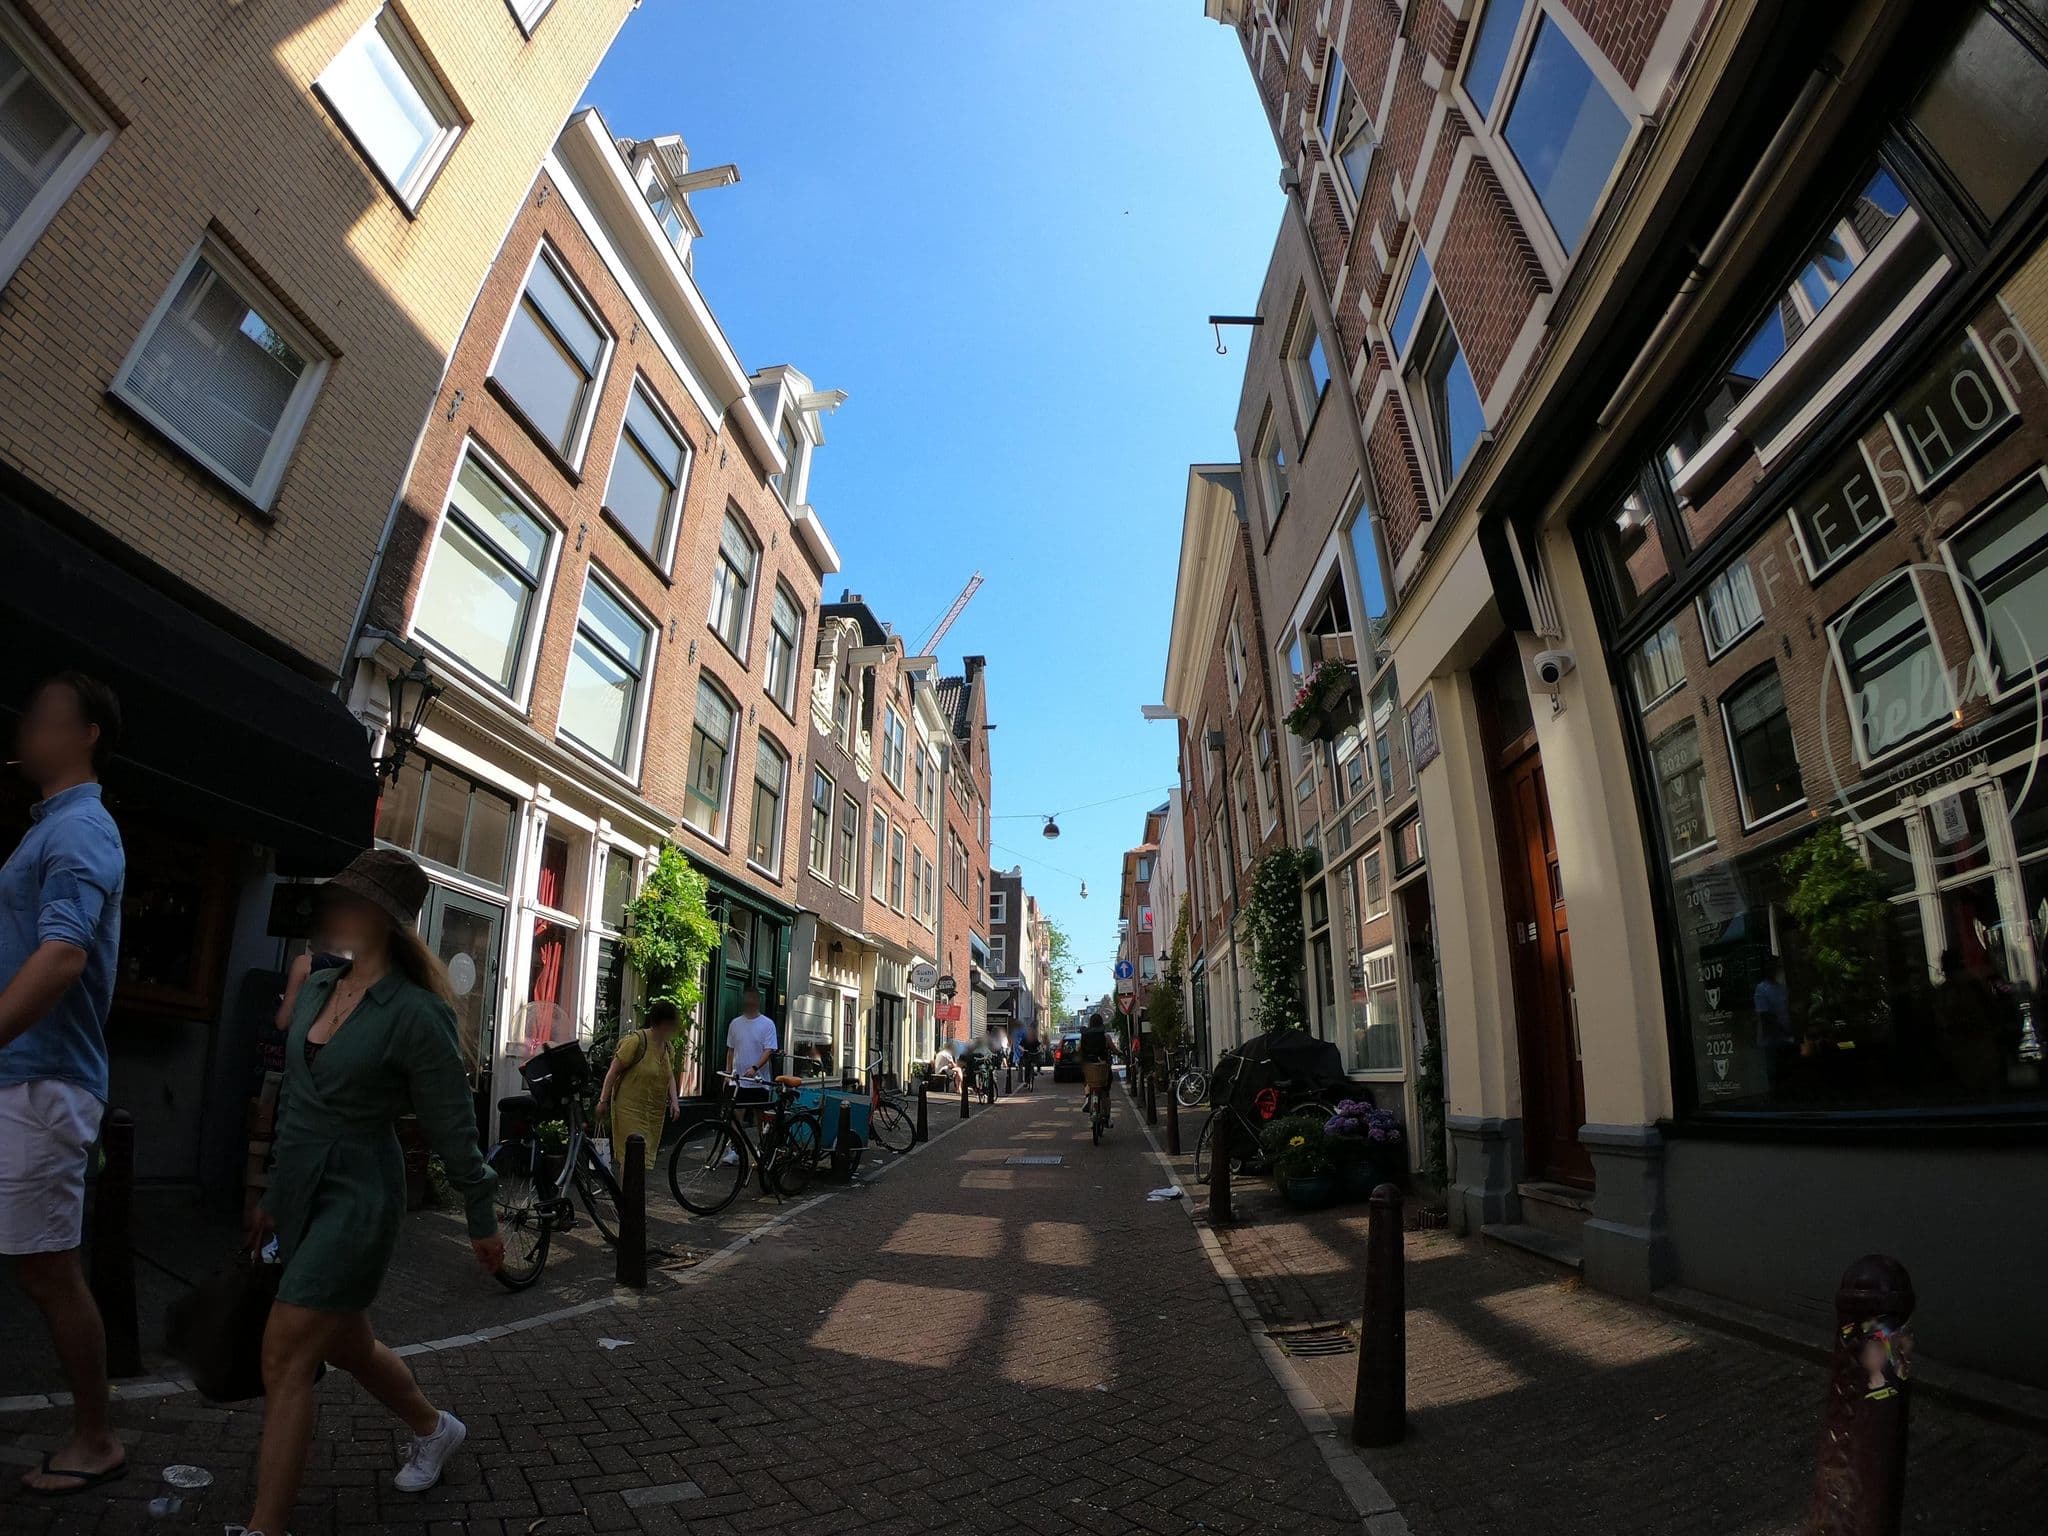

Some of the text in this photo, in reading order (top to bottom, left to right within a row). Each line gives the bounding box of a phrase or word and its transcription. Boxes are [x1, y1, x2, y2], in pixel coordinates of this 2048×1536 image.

[1662, 750, 1688, 775] 2020
[1887, 725, 1983, 784] COFFEESHOP
[1895, 748, 1989, 805] AMSTERDAM
[1686, 887, 1711, 909] 2019
[1698, 963, 1723, 982] 2019
[1706, 1039, 1734, 1056] 2022
